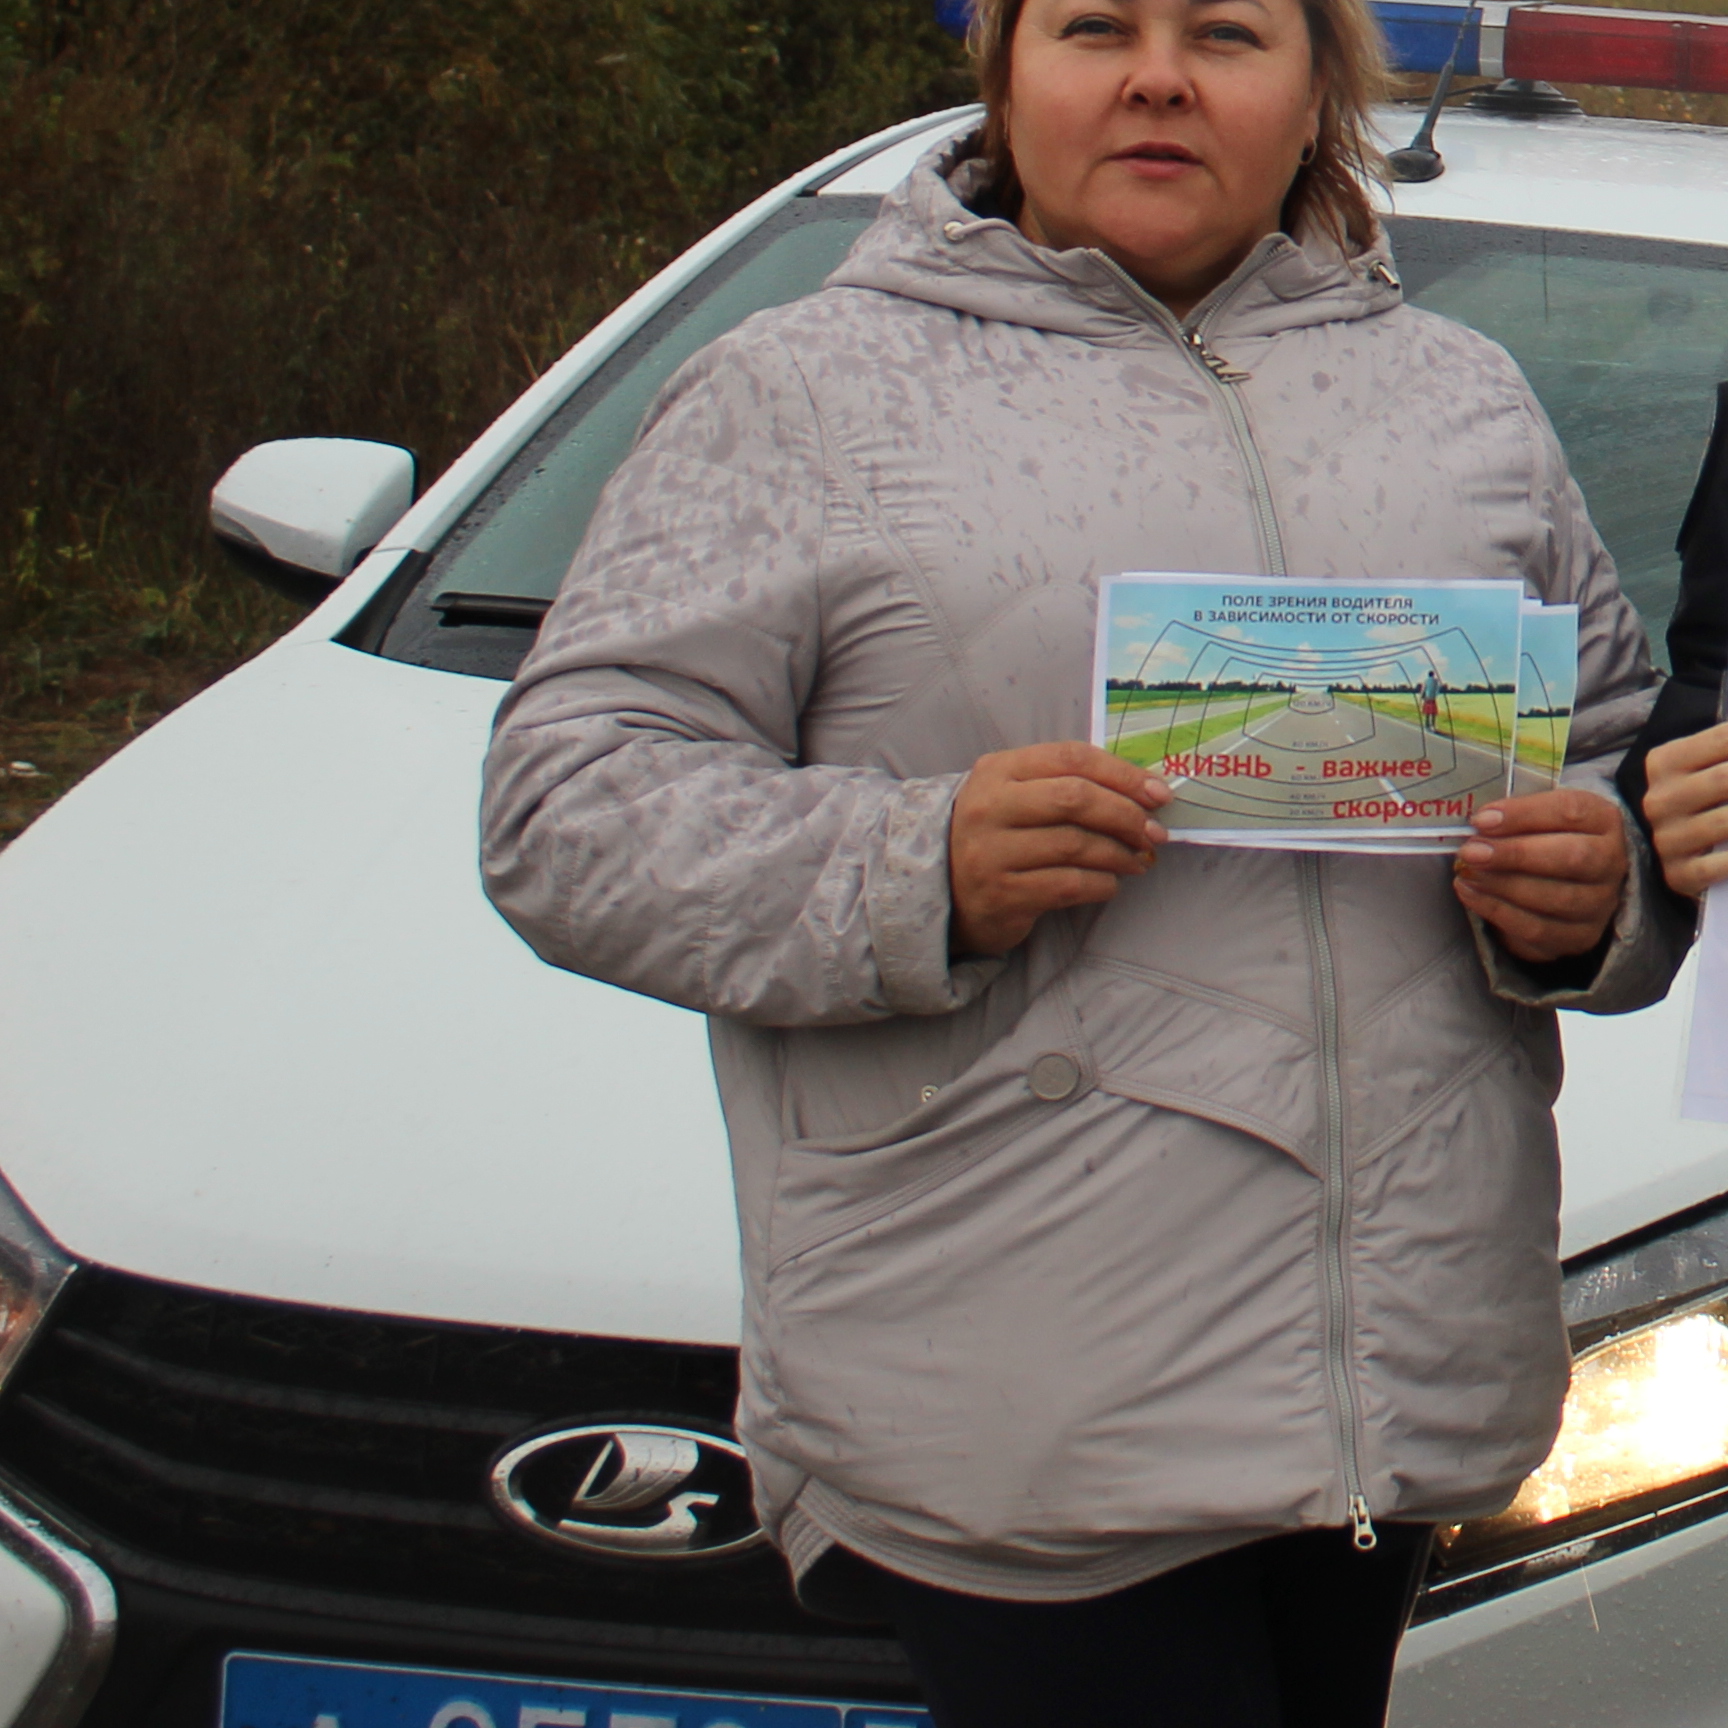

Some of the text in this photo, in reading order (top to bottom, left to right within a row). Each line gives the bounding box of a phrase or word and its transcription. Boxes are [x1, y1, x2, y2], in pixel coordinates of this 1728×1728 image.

[1222, 595, 1413, 610] ПОЛЕ ЗРЕНИЯ ВОДИТЕЛЯ
[1194, 610, 1440, 625] В ЗАВИСИМОСТИ ОТ СКОРОСТИ
[1163, 754, 1272, 778] ЖИЗНЬ
[1322, 759, 1432, 778] важнее
[1333, 793, 1475, 823] скорости!
